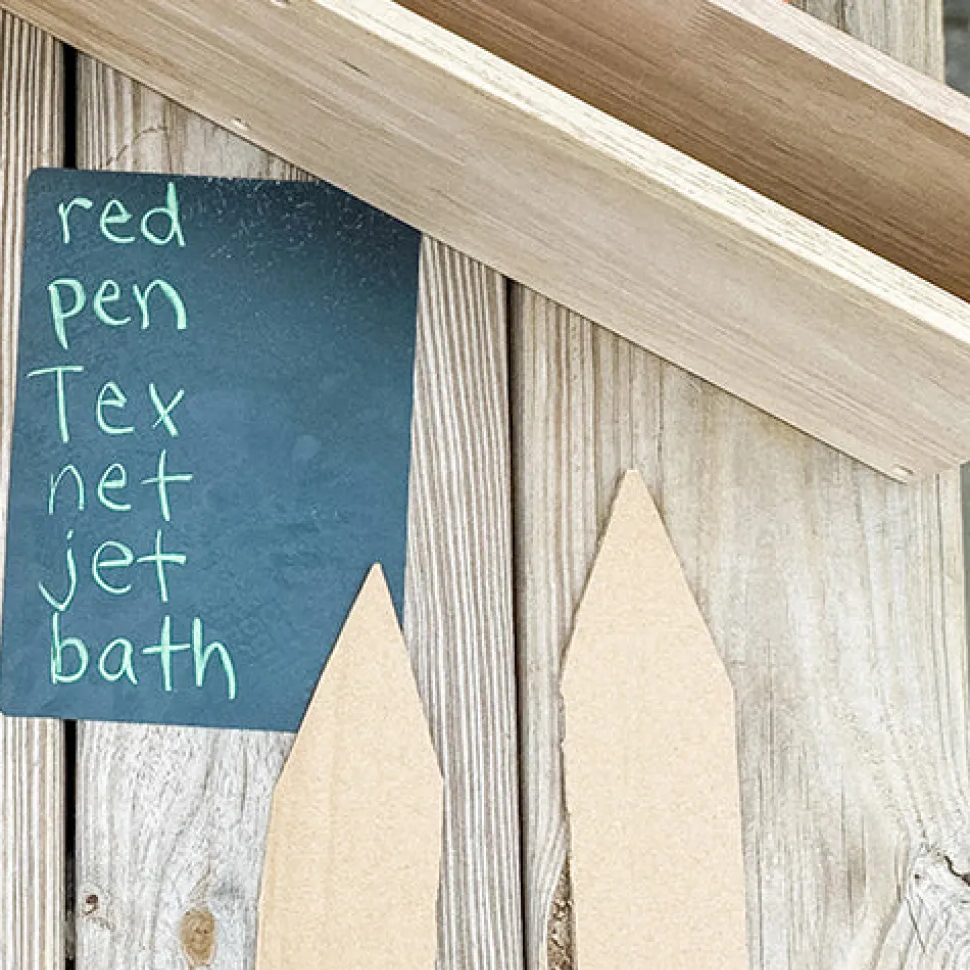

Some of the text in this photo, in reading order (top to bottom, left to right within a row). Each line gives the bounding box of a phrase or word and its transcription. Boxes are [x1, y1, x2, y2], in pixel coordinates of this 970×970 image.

[57, 181, 187, 248] red
[48, 278, 188, 350] pen
[26, 364, 187, 444] Tex
[47, 447, 194, 523] net
[37, 528, 188, 613] jet
[50, 611, 237, 701] bath
